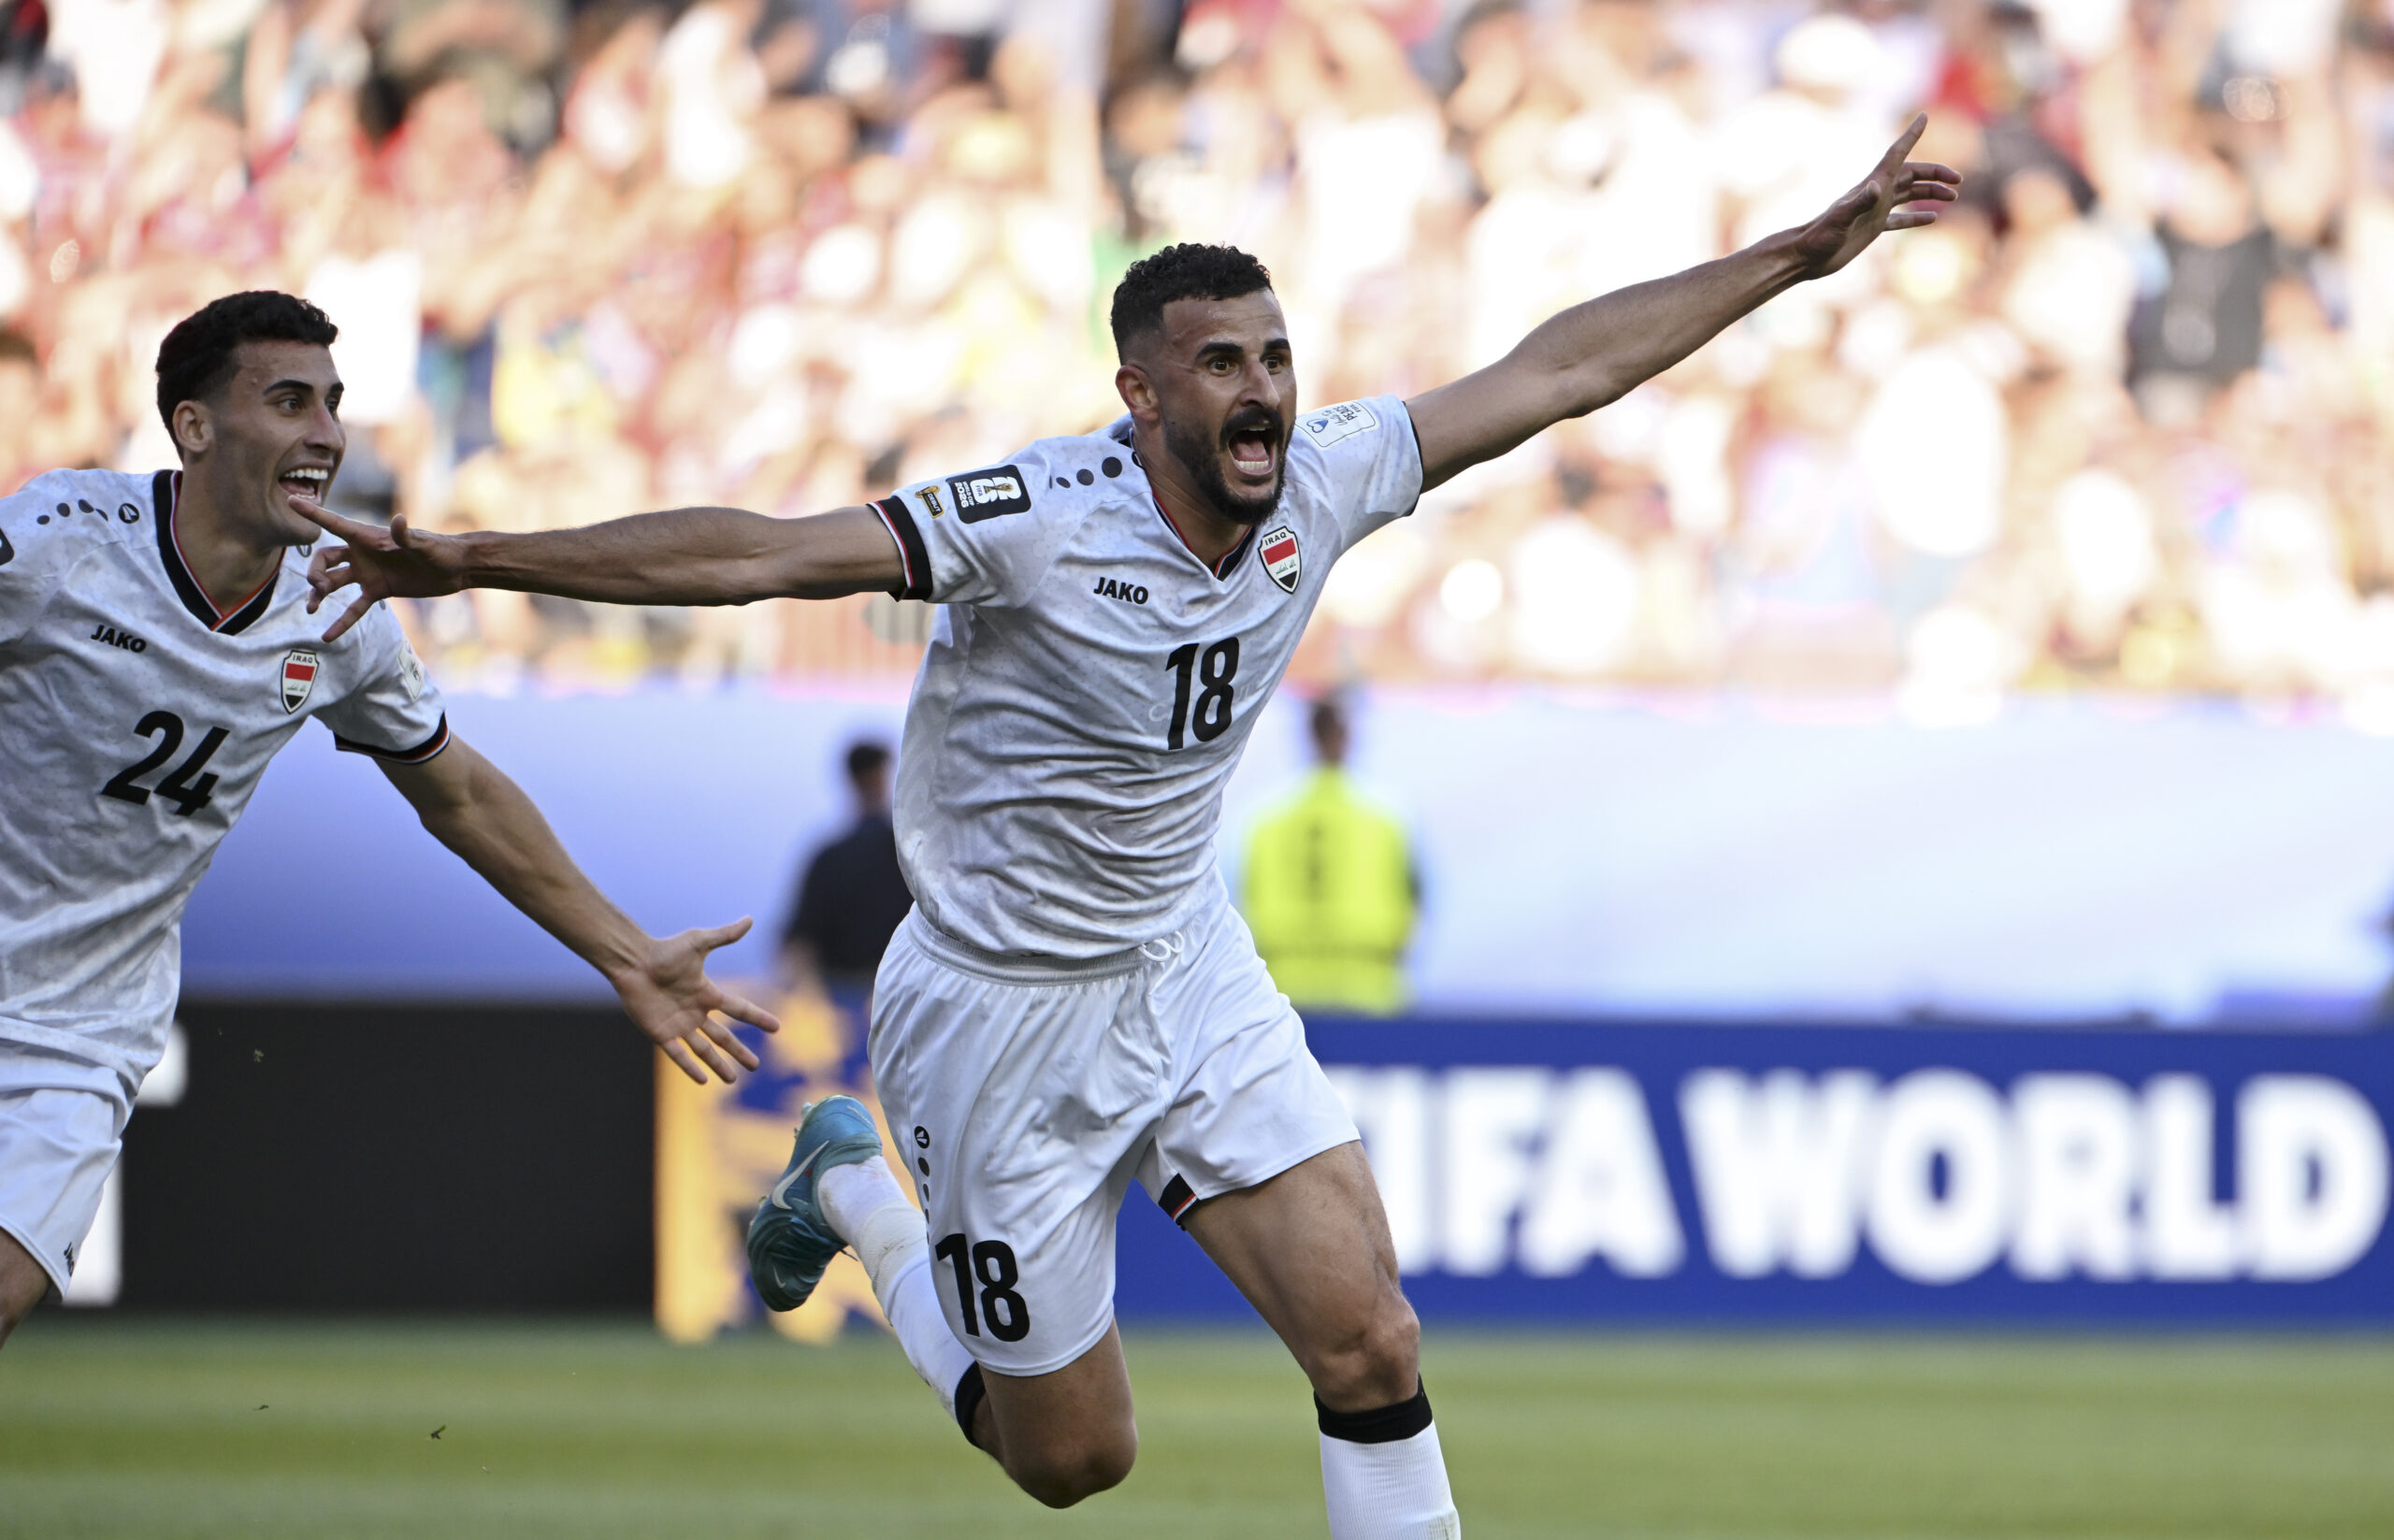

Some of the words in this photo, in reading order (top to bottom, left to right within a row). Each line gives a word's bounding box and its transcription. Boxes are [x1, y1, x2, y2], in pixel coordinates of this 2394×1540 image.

[927, 493, 941, 511] DEBUT
[954, 482, 969, 508] 2026
[1264, 531, 1287, 546] IRAQ
[1093, 577, 1148, 605] JAKO
[91, 625, 147, 653] JAKO
[292, 655, 313, 664] IRAQ
[1165, 637, 1239, 750] 18
[101, 711, 230, 816] 24
[1680, 1068, 2390, 1285] WORLD
[935, 1233, 1030, 1342] 18
